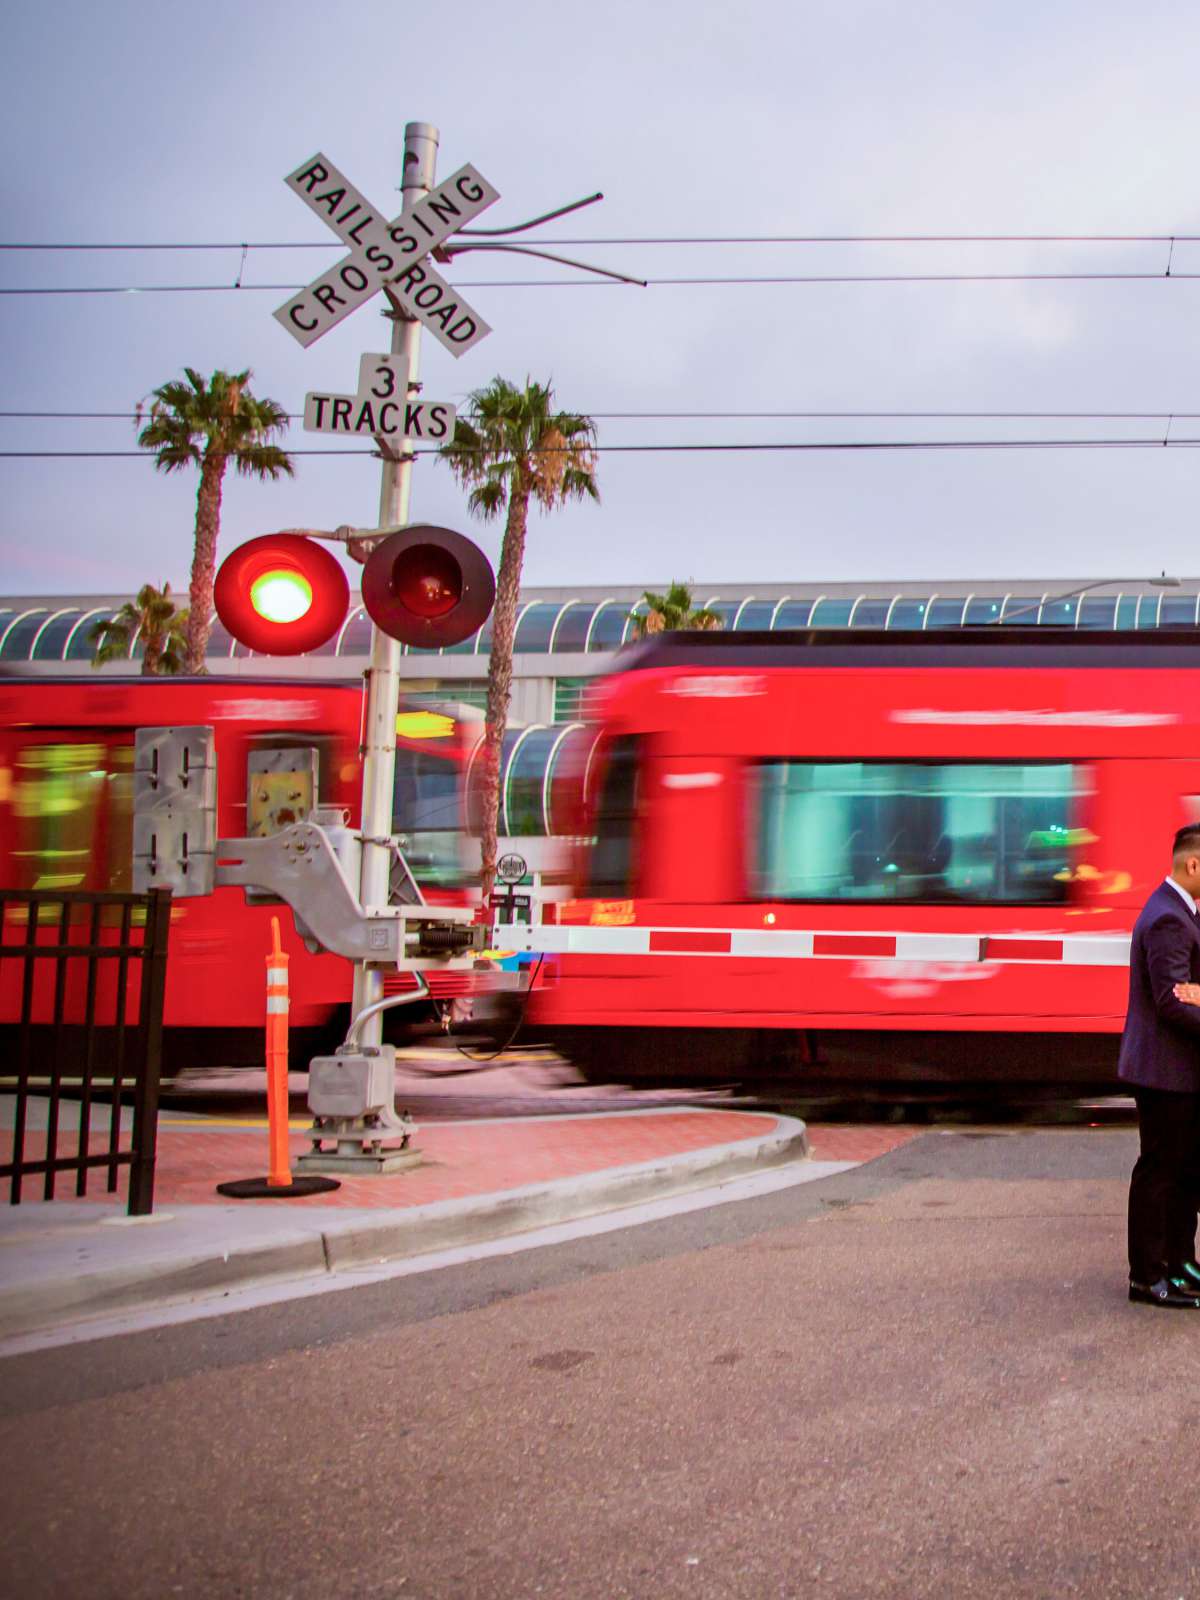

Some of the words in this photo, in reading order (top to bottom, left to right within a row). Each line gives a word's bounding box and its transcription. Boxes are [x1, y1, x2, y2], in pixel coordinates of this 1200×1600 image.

[290, 176, 484, 331] CROSSING
[371, 366, 395, 398] 3
[312, 396, 447, 437] TRACKS
